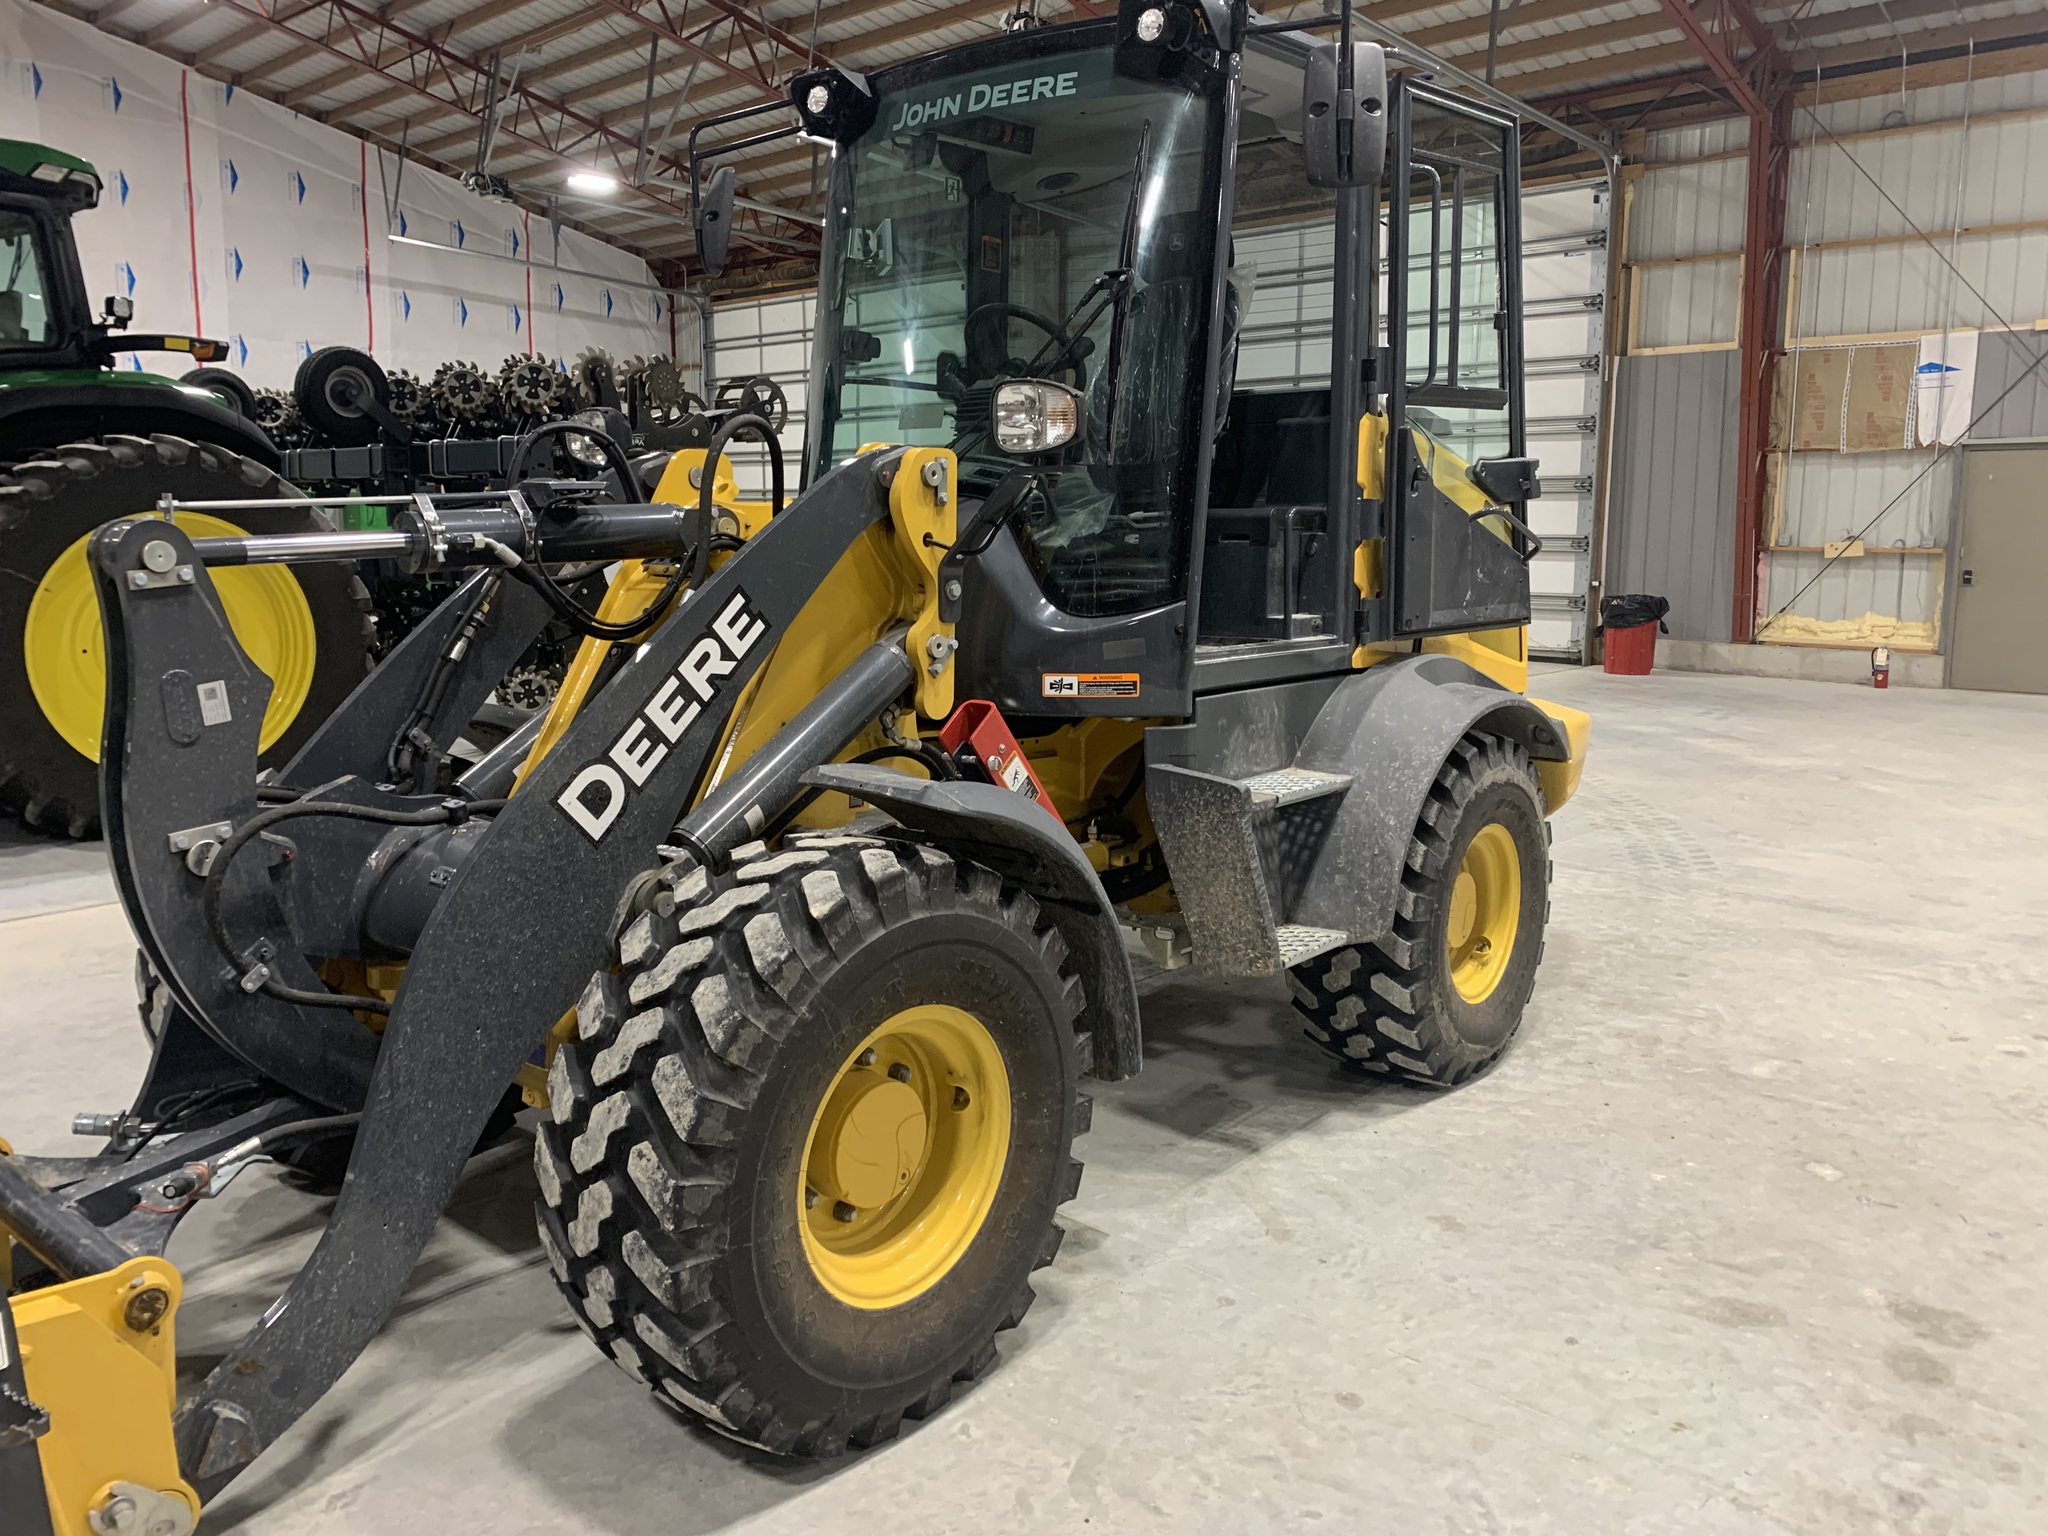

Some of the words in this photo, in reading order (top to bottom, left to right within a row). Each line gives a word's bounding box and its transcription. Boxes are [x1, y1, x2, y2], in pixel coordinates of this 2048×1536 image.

[892, 93, 962, 132] JOHN
[967, 71, 1079, 113] DEERE
[556, 592, 766, 842] DEERE
